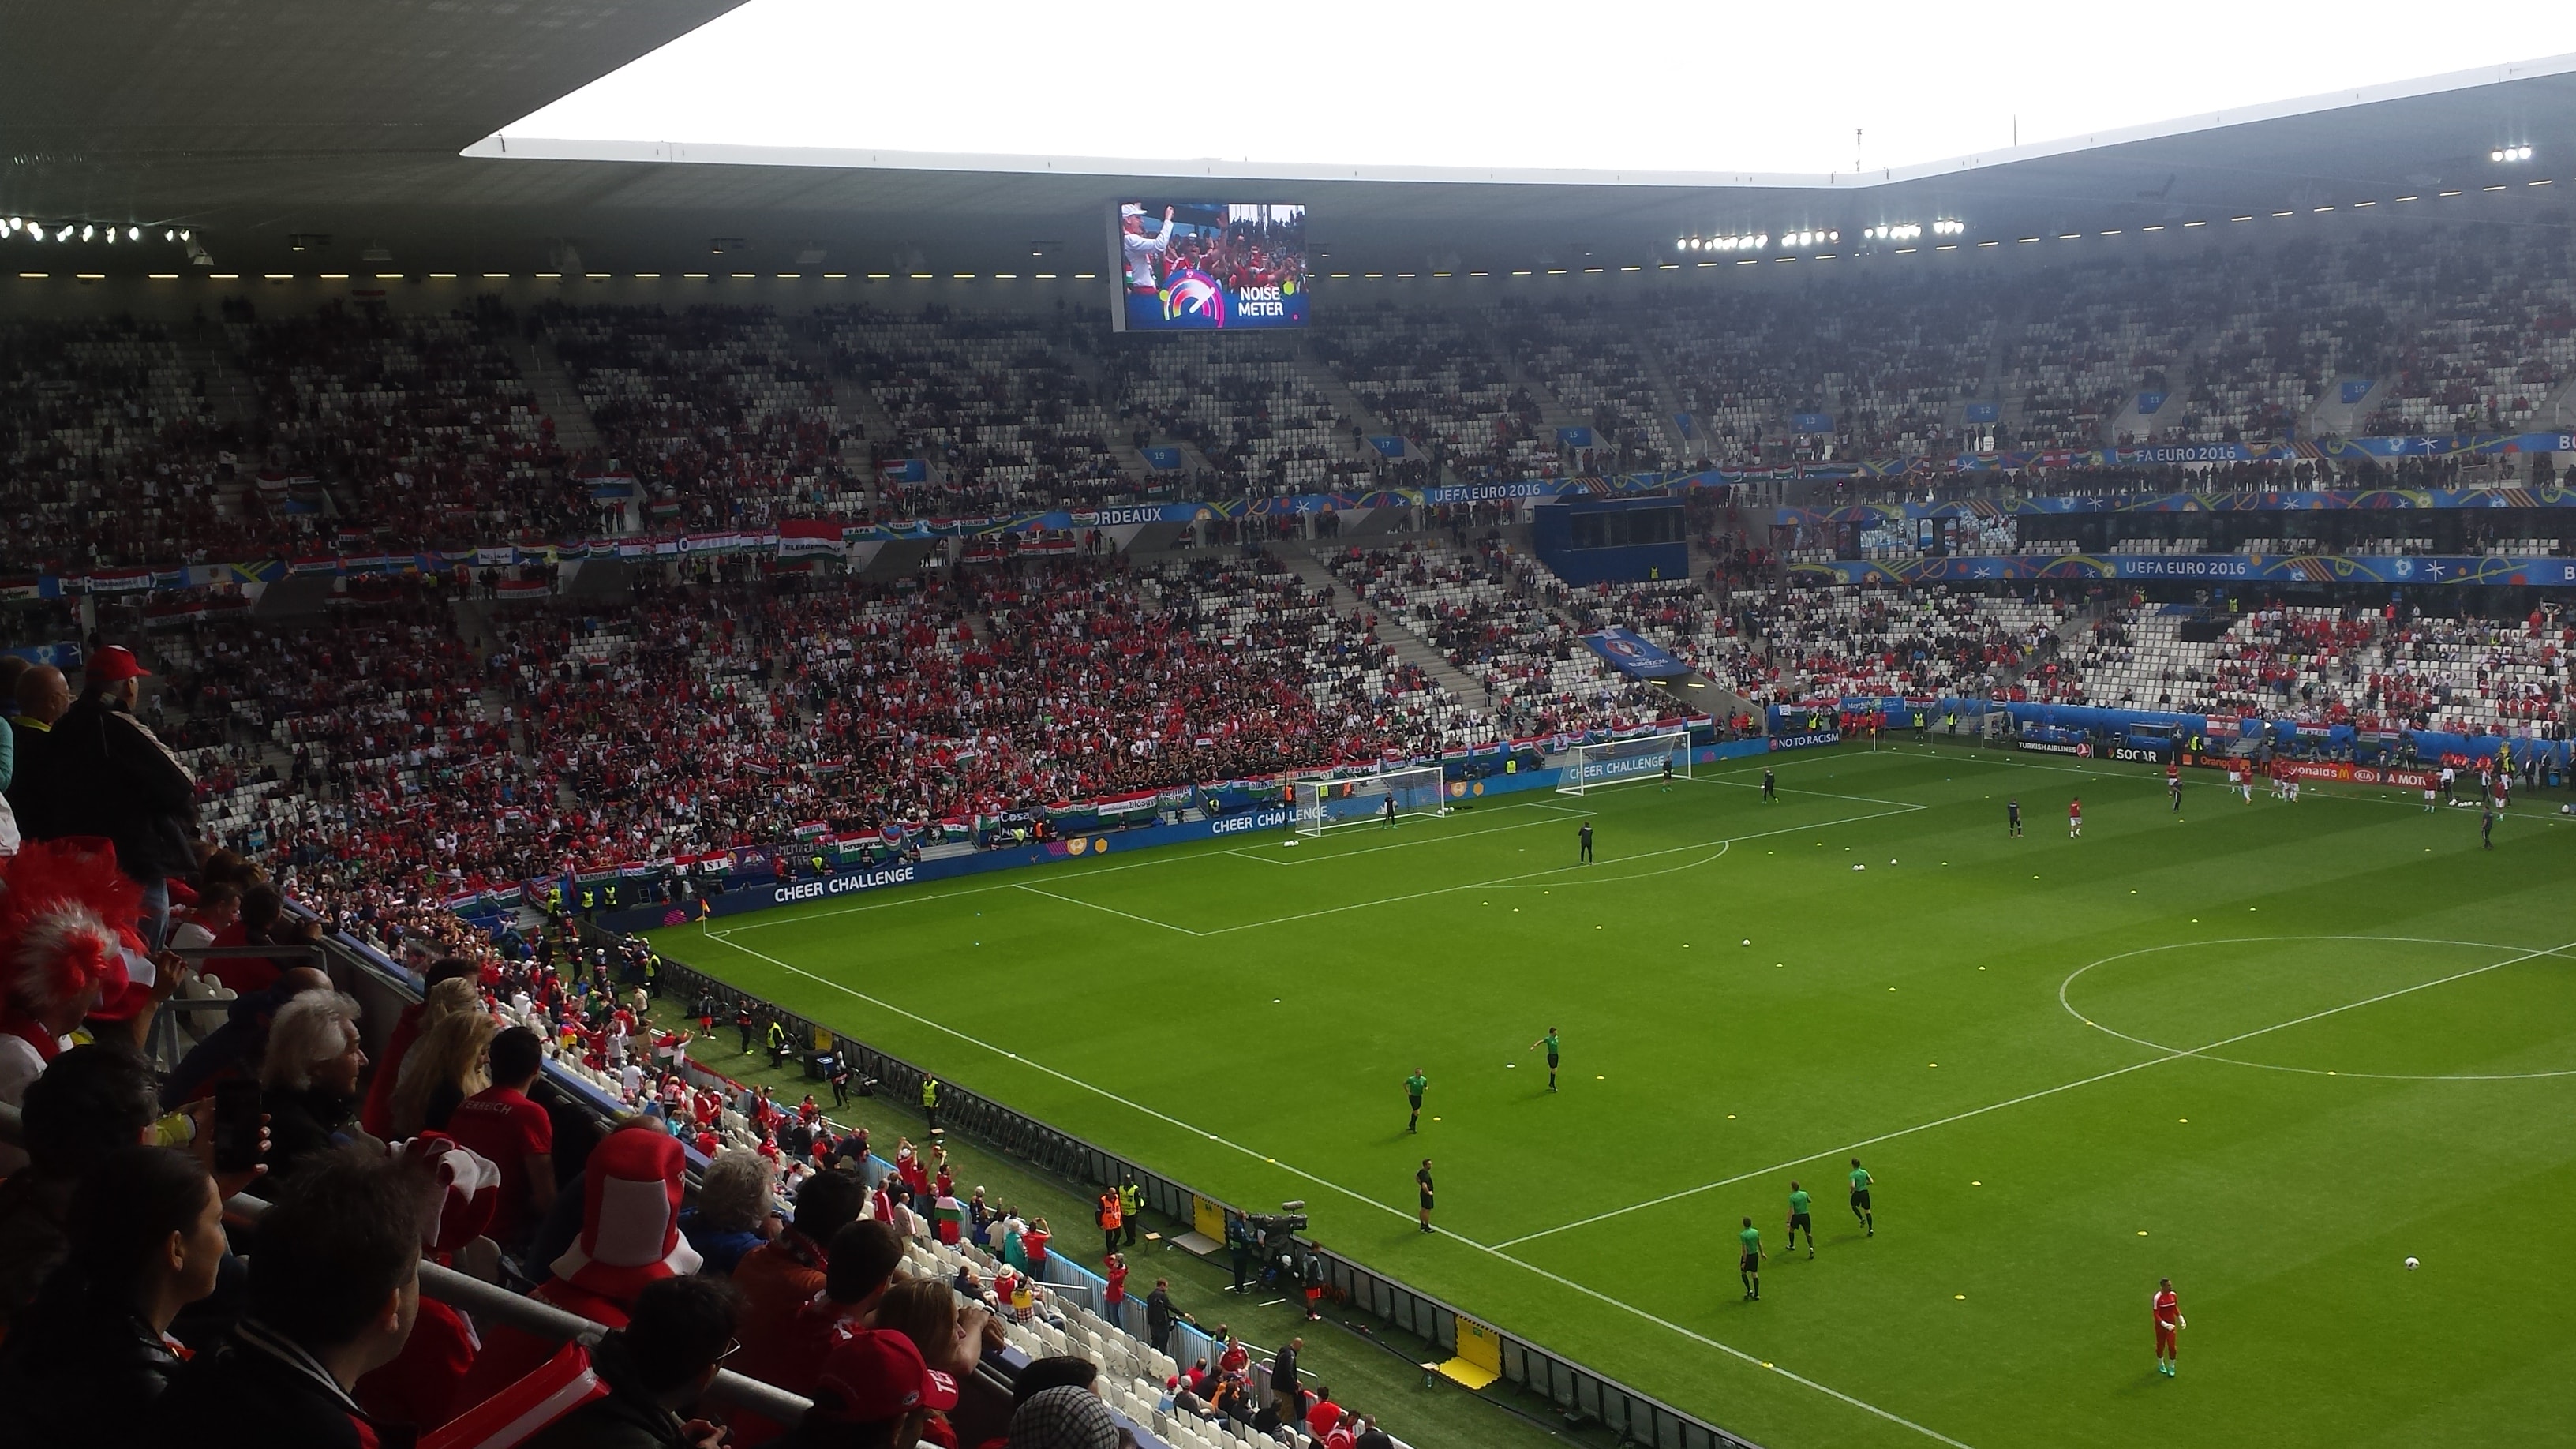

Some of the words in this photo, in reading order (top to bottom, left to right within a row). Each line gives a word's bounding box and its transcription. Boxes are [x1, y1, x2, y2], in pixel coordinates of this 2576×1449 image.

[1240, 286, 1280, 301] NOISE
[1238, 302, 1284, 316] METER
[1568, 430, 1578, 439] 15
[1380, 440, 1391, 449] 17
[1155, 451, 1165, 460] 19
[2157, 447, 2196, 462] EURO
[2199, 446, 2236, 460] 2016
[1433, 486, 1469, 503] UEFA
[1471, 485, 1506, 500] EURO
[1509, 483, 1541, 498] 2016
[1093, 507, 1163, 526] ORDEAUX
[2126, 560, 2164, 575] UEFA
[2166, 561, 2206, 575] EURO
[2209, 561, 2246, 575] 2016
[1778, 738, 1792, 748] NO
[1794, 736, 1806, 747] TO
[1807, 732, 1839, 745] RACISM
[2018, 741, 2046, 751] TURKISH
[2046, 744, 2076, 754] AIRLINES
[1569, 765, 1604, 780] CHEER
[1607, 755, 1665, 774] CHALLENGE
[1212, 816, 1253, 834] CHEER
[1257, 805, 1328, 828] CHALLENGE
[773, 880, 825, 903] CHEER
[829, 866, 915, 894] CHALLENGE
